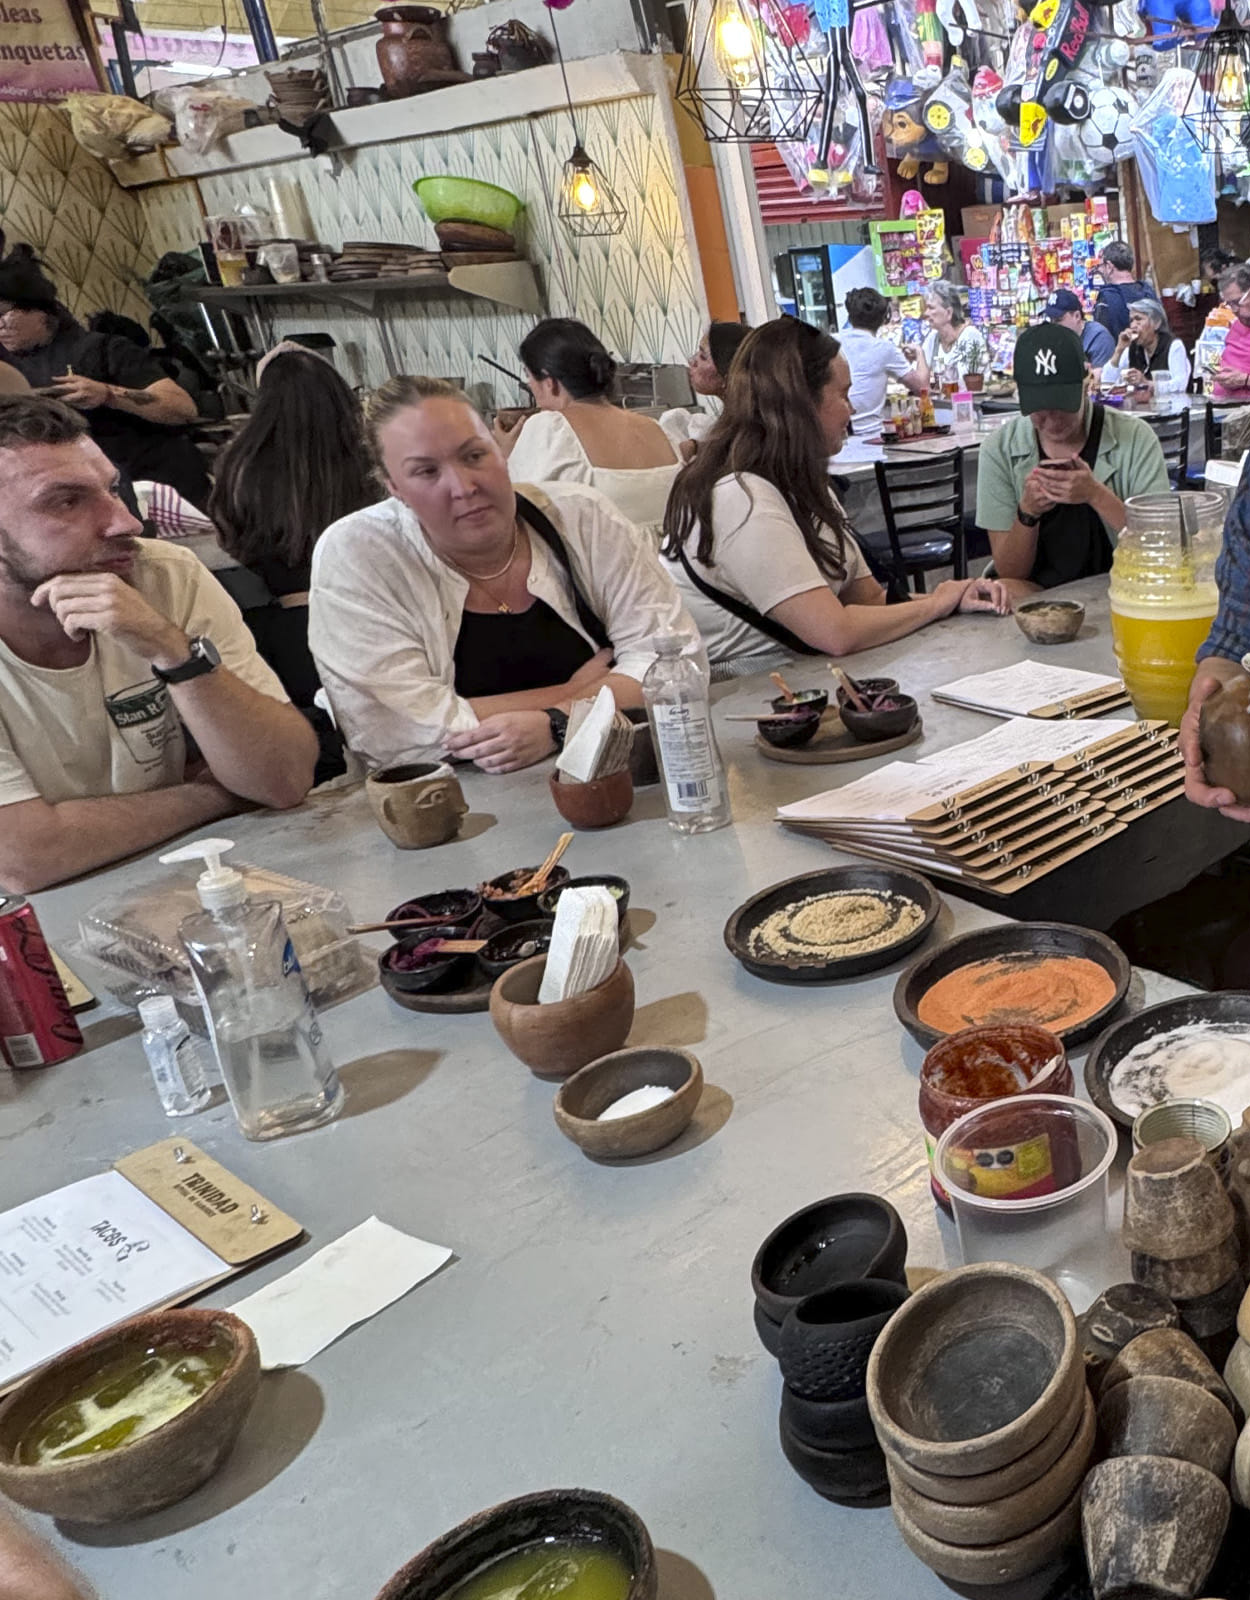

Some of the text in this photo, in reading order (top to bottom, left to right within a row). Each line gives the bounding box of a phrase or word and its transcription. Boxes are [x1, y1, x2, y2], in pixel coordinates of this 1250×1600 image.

[1034, 348, 1057, 376] NY
[181, 1172, 240, 1215] TRINIDAD
[90, 1219, 128, 1247] TACOS
